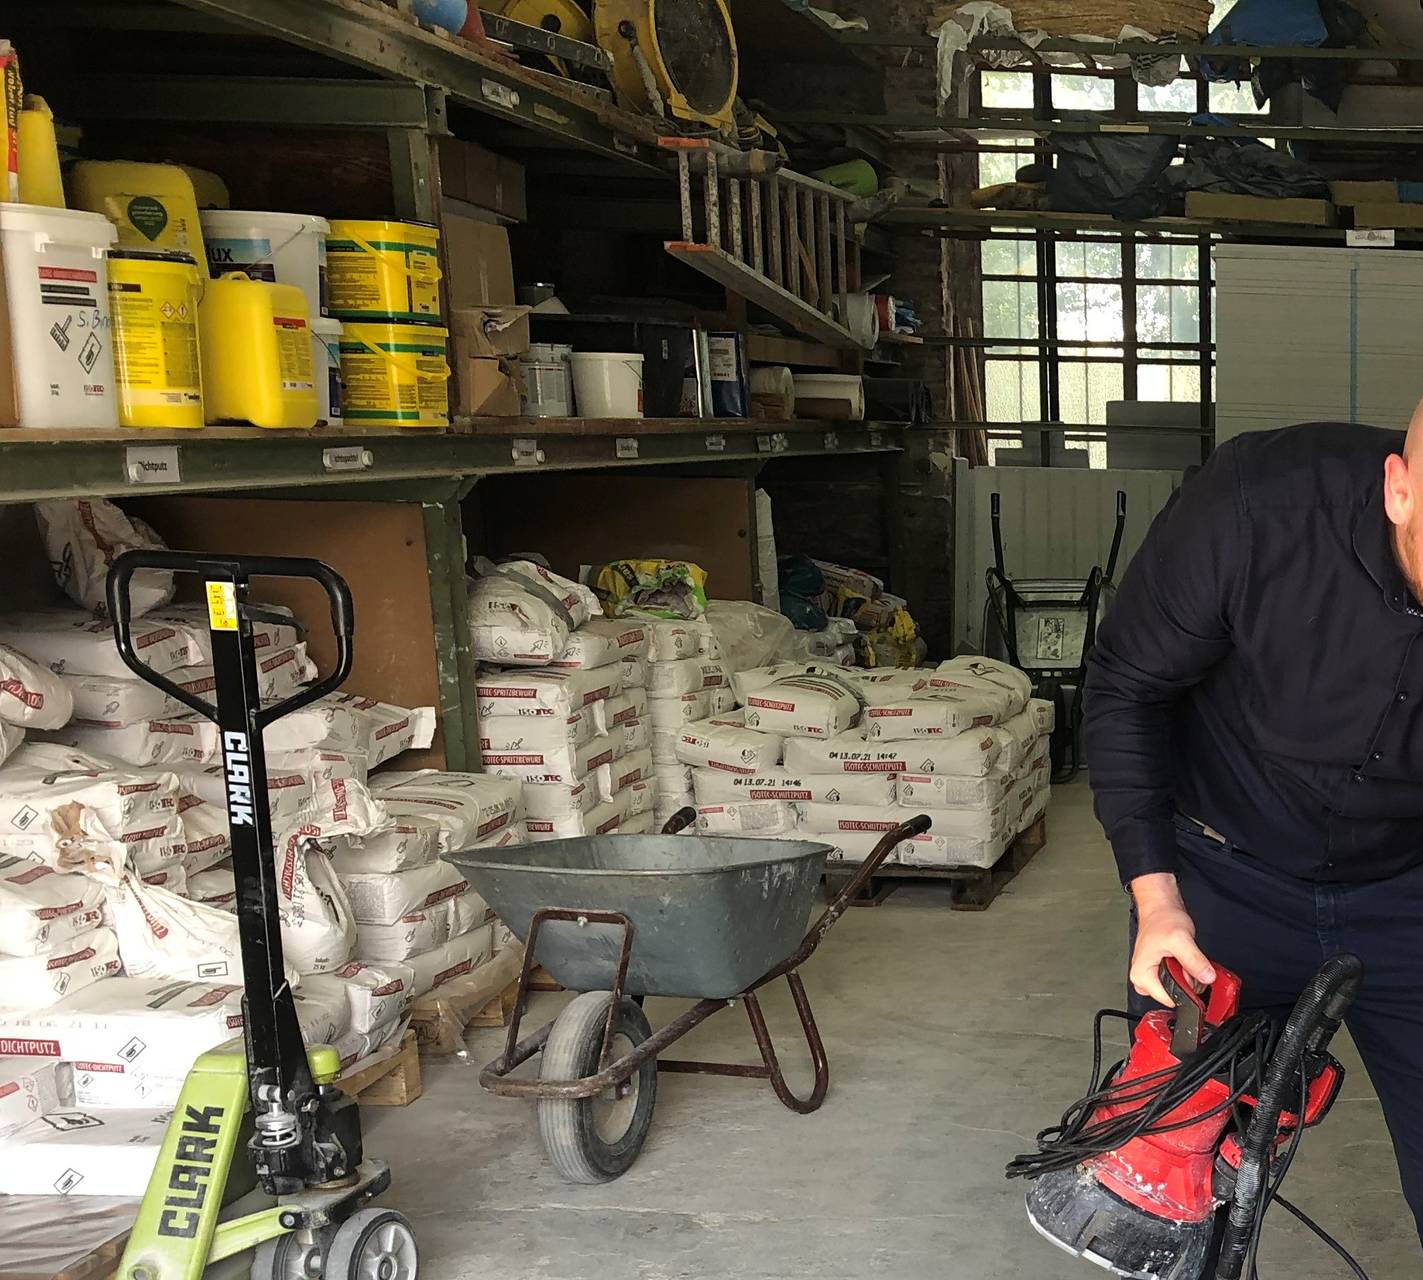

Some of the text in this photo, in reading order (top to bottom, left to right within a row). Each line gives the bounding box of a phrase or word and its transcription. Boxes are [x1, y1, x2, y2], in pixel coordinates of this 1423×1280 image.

[223, 731, 254, 826] CLARK
[839, 752, 872, 761] 13.07.21
[0, 1039, 56, 1055] DICHTPUTZ
[157, 1105, 224, 1238] CLARK
